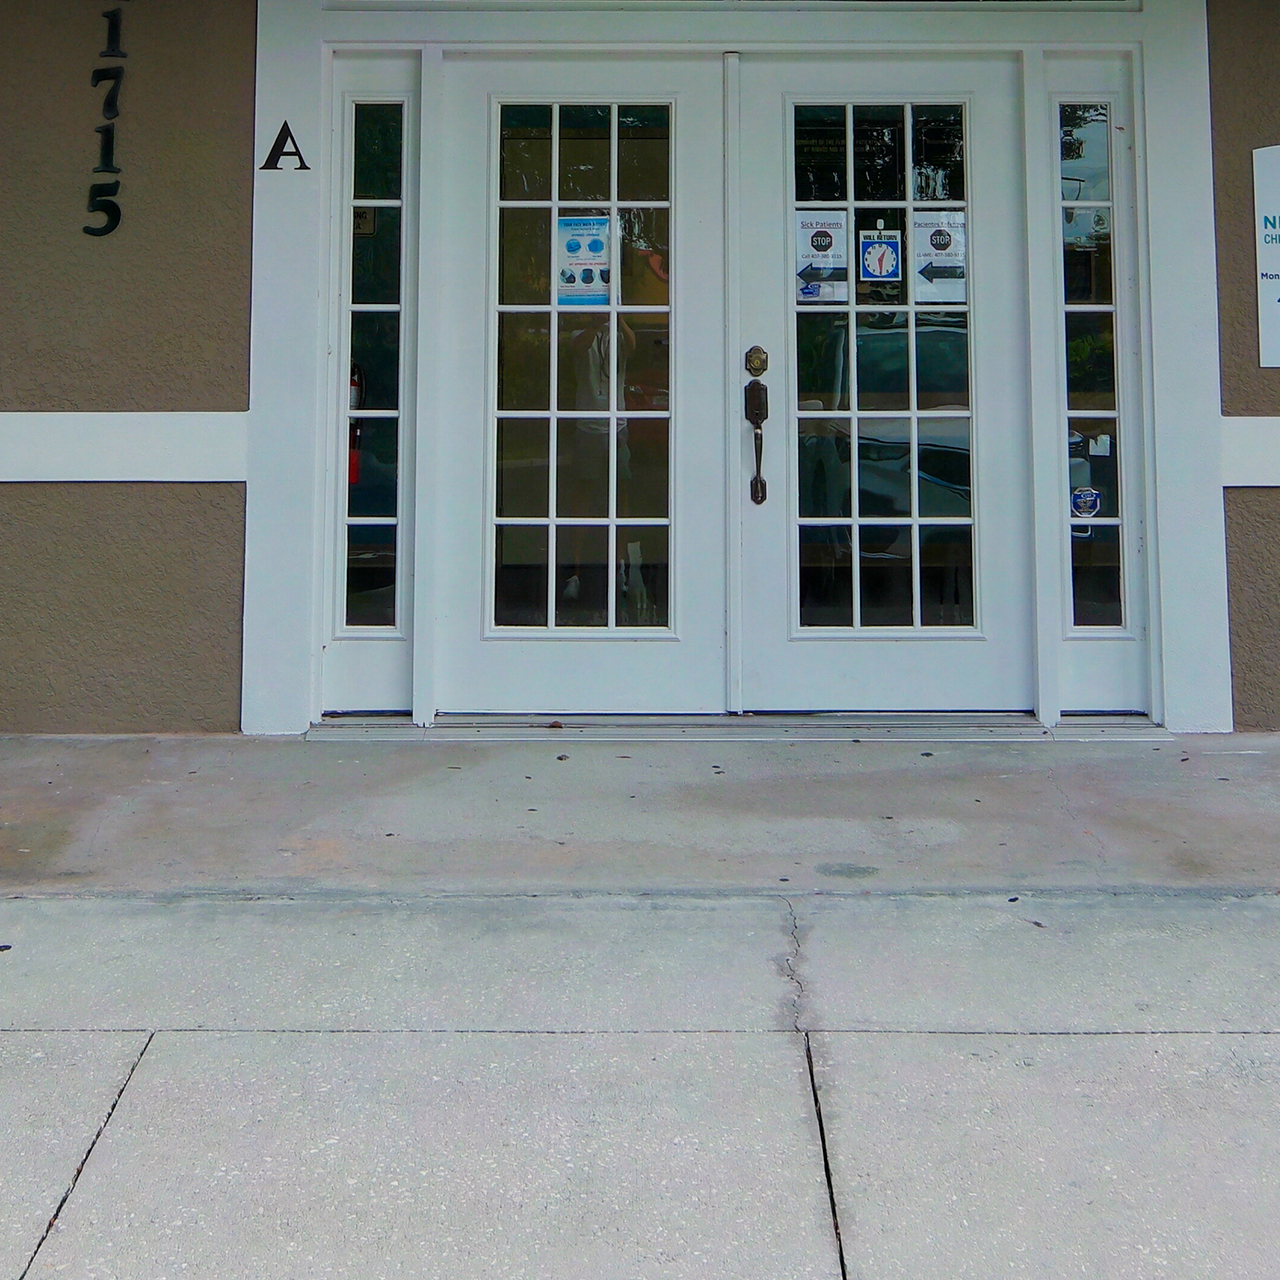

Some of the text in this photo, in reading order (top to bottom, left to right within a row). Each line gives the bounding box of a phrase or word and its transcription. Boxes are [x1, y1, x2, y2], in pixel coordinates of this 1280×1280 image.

[259, 119, 312, 170] A
[812, 236, 832, 246] STOP
[931, 235, 950, 245] STOP
[1260, 272, 1280, 280] Mon
